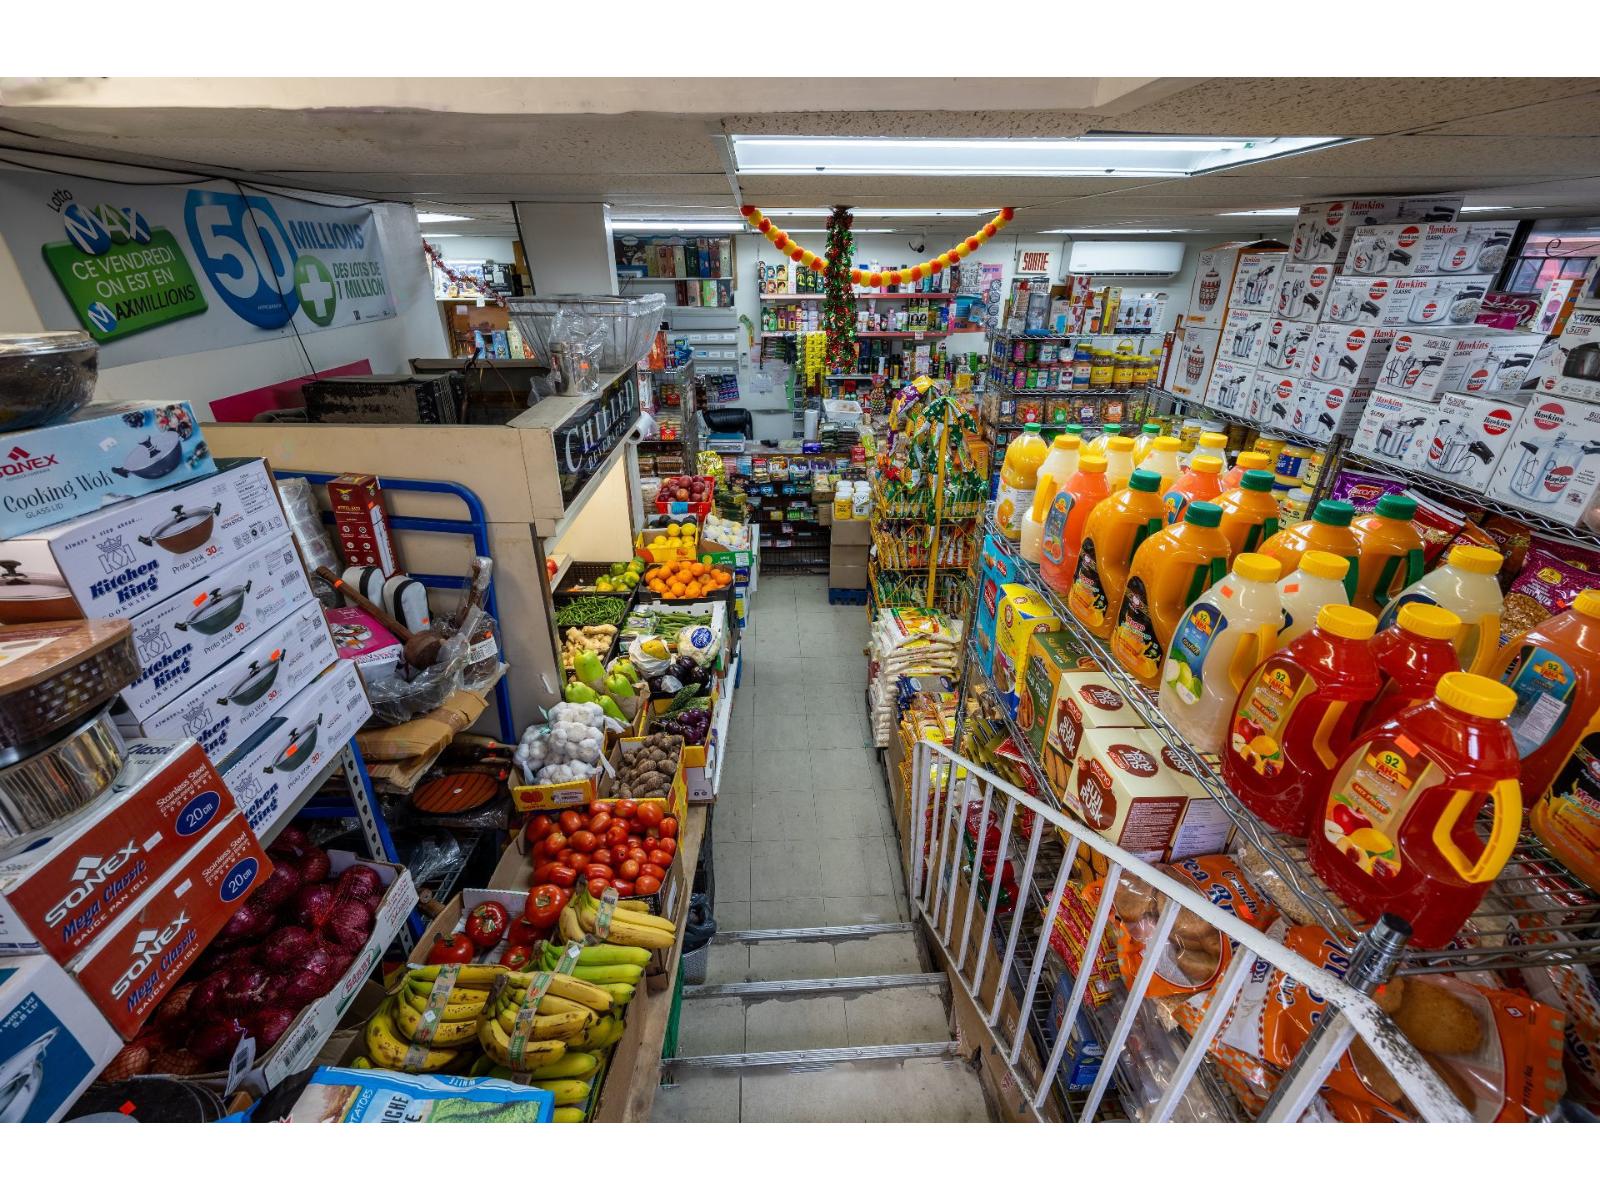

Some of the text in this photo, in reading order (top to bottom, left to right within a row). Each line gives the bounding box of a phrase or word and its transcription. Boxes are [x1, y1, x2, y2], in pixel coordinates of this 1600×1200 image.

[1352, 200, 1385, 210] Hawkins
[65, 203, 151, 255] MAX
[288, 219, 366, 251] MILLIONS
[1427, 225, 1458, 235] Hawkins
[72, 246, 176, 281] CE VENDREDI
[195, 204, 295, 300] 50
[1022, 252, 1050, 271] SORTIE
[96, 267, 175, 298] ON EST EN
[332, 260, 382, 279] DES LOTS DE
[1395, 280, 1428, 289] Hawkins
[345, 278, 386, 300] MILLION
[1374, 329, 1398, 338] Hawki
[1456, 340, 1490, 350] Hawkins
[1351, 389, 1371, 398] Hawk
[565, 379, 635, 473] CHILLED
[1484, 416, 1511, 428] Hawkins
[1535, 410, 1564, 423] Hawkins
[4, 480, 78, 513] Cooking
[205, 545, 218, 557] 30
[89, 559, 160, 600] Kitchen
[117, 573, 159, 604] King
[103, 593, 151, 619] OOKWARE
[234, 622, 246, 634] 30
[153, 657, 191, 690] King
[1275, 672, 1286, 682] 92
[197, 715, 232, 743] chen
[204, 729, 229, 755] ing
[1385, 754, 1400, 768] 92
[156, 763, 207, 807] Stainless Steel
[1087, 778, 1103, 810] SUJI
[1080, 785, 1104, 827] RUSK
[202, 831, 247, 876] Stainless Steel
[45, 840, 139, 928] SONEX
[63, 859, 147, 944] Mega Classic
[74, 913, 109, 947] SAUCE
[109, 893, 130, 914] PAN
[111, 910, 191, 1001] SONEX
[127, 928, 197, 1013] Mega Classic
[136, 982, 167, 1016] SAUCE
[166, 961, 183, 981] PAN
[3, 996, 36, 1030] with Lid
